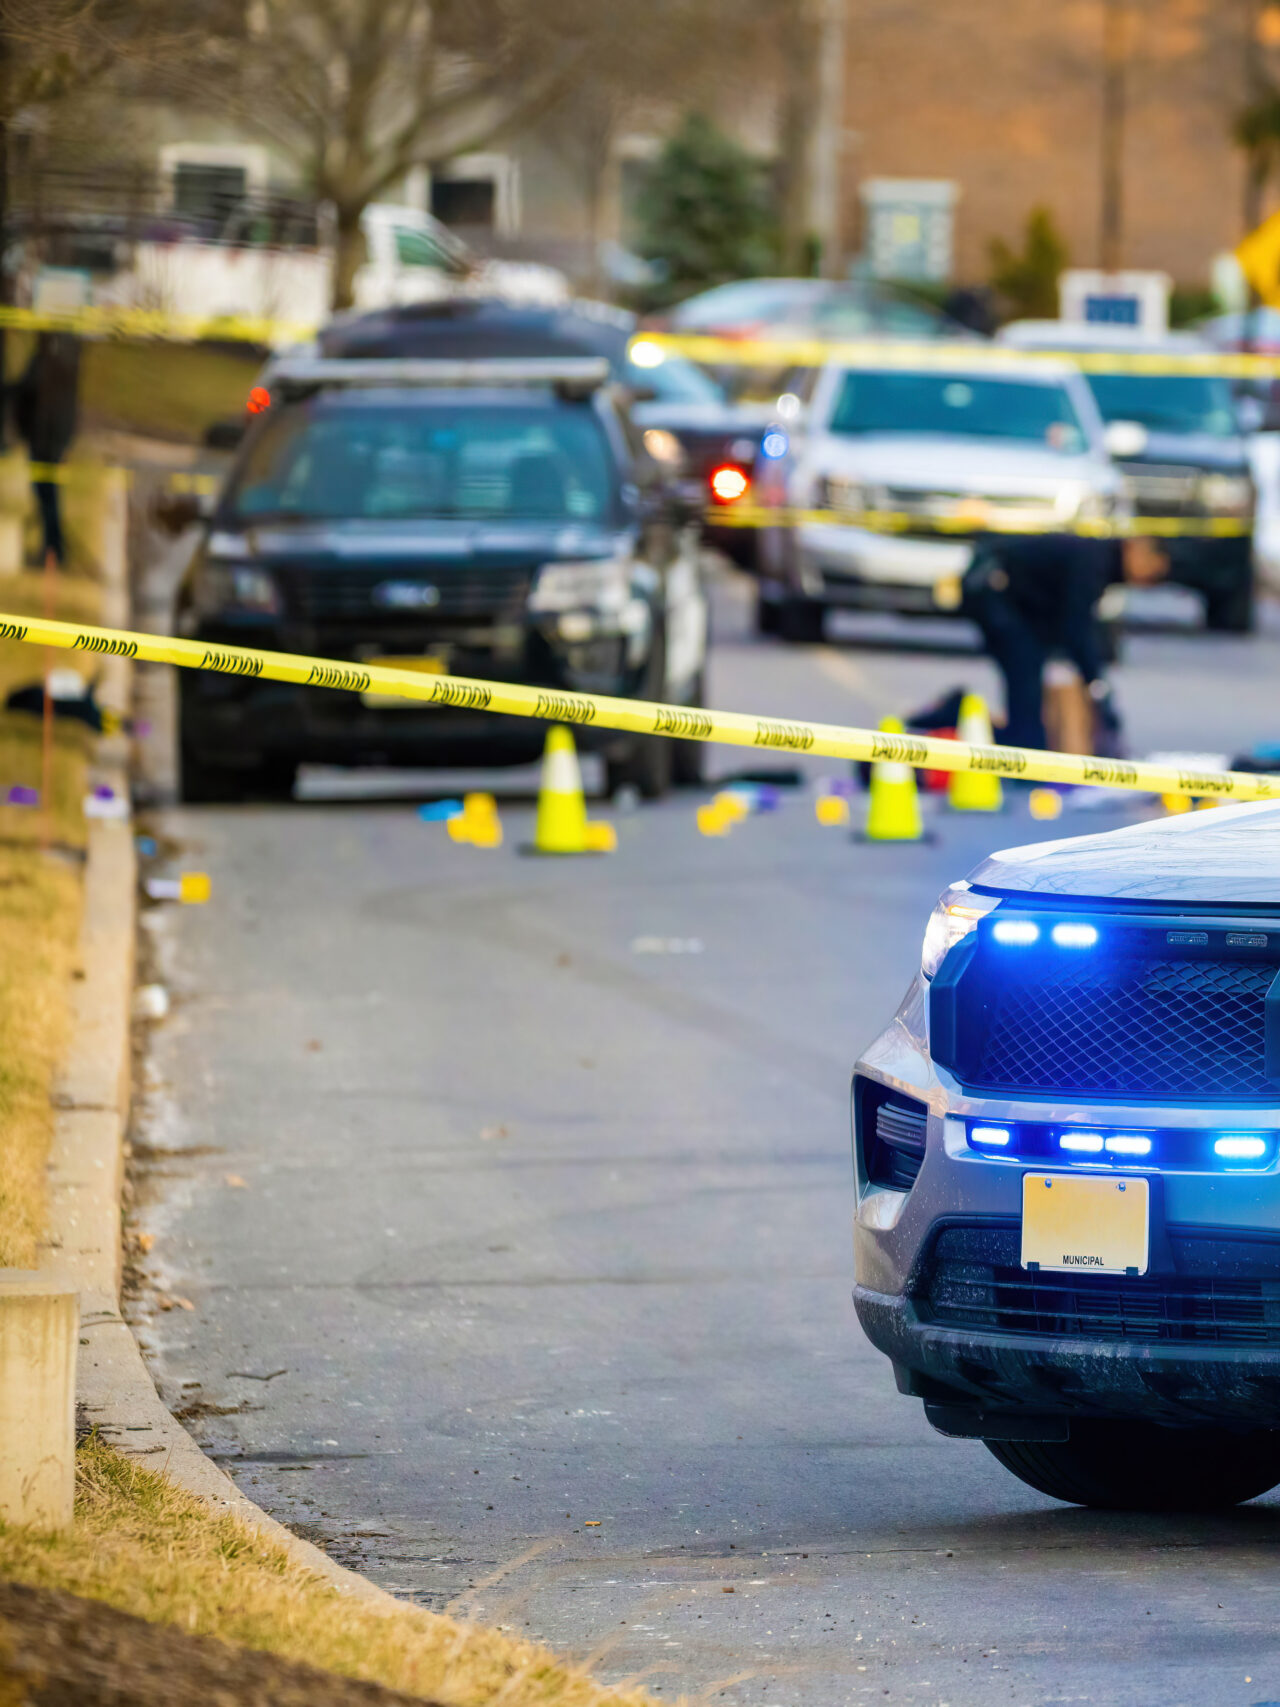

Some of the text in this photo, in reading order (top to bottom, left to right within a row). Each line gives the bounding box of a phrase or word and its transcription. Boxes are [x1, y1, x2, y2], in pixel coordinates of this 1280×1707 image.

[71, 633, 139, 657] CUIDADO
[200, 650, 264, 677] CAUTION
[307, 664, 371, 692] CUIDADO
[428, 681, 492, 710] CAUTION
[532, 694, 597, 724] CUIDADO
[653, 708, 713, 738] CAUTION
[754, 721, 815, 750] CUIDADO
[871, 735, 928, 763] CAUTION
[1062, 1254, 1105, 1265] MUNICIPAL
